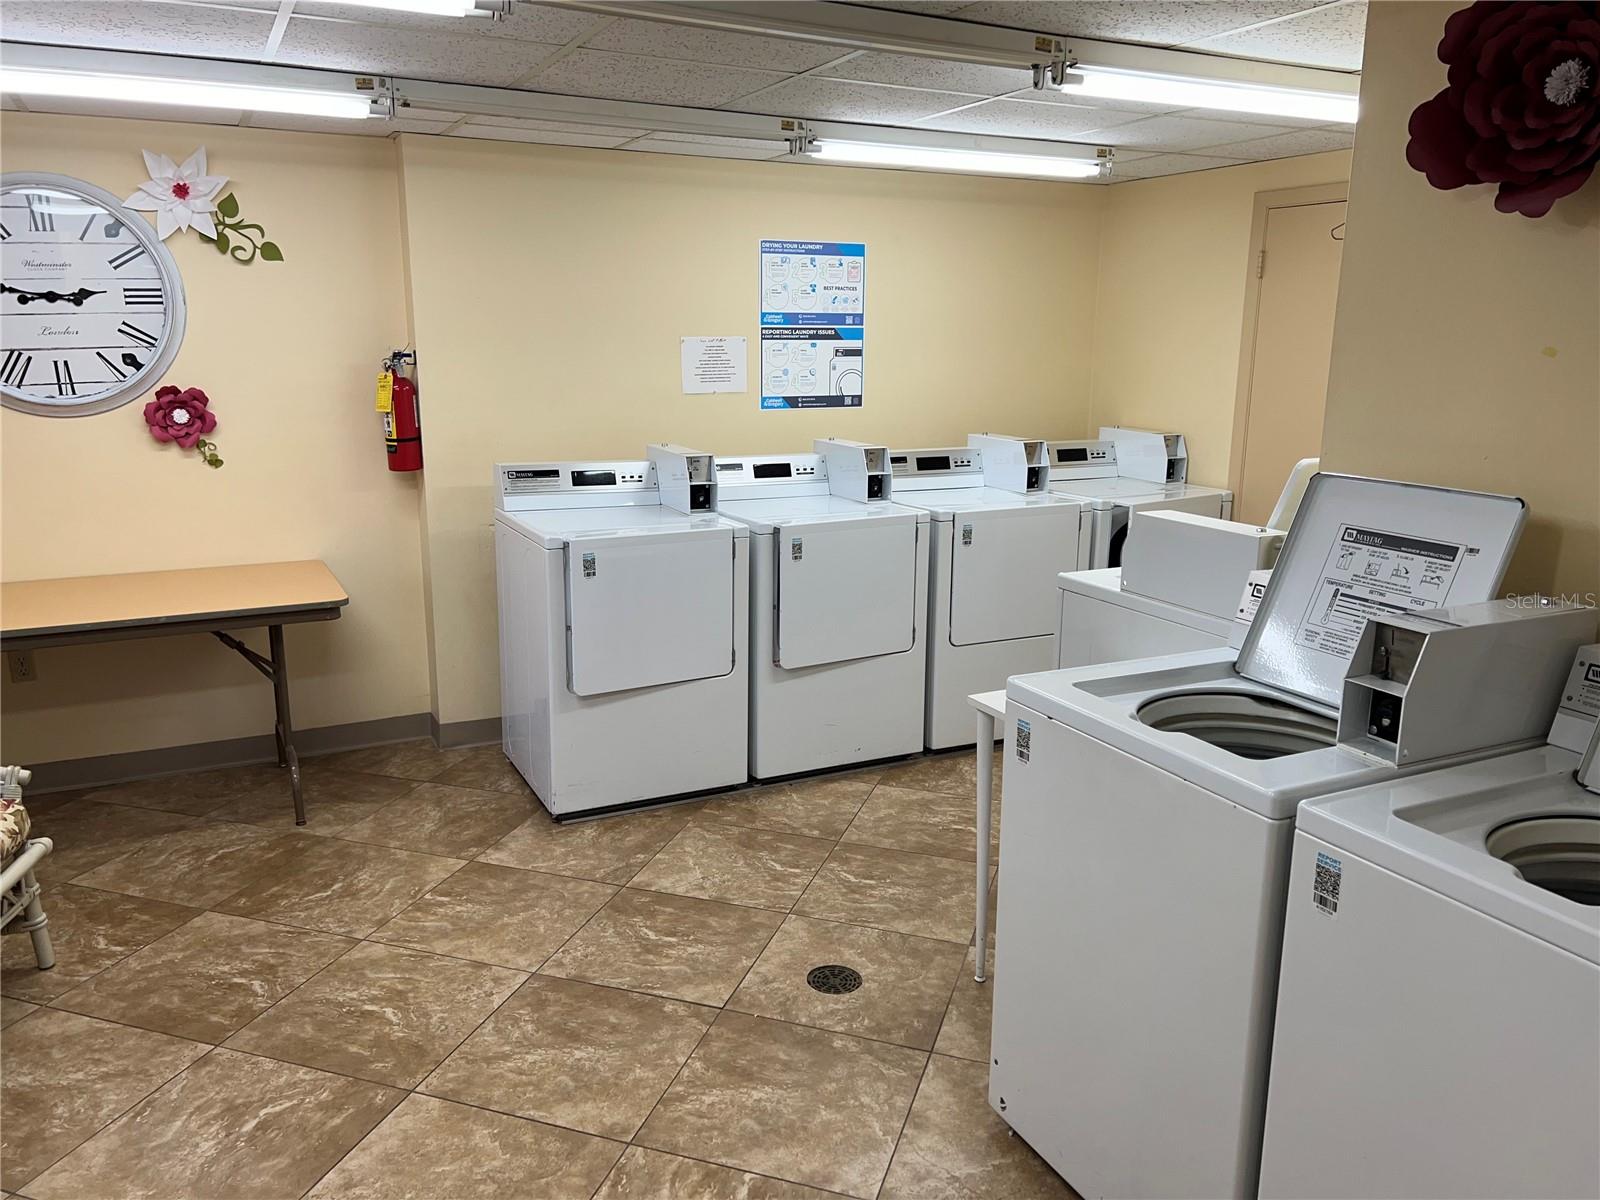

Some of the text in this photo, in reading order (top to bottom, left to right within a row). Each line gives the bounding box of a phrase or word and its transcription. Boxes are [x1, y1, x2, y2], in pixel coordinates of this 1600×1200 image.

[21, 259, 72, 268] Westminster
[37, 325, 79, 337] London
[1355, 533, 1383, 546] MAYTAG
[1420, 550, 1453, 560] INSTRUCTIONS
[1326, 579, 1354, 590] TEMPERATURE
[1410, 599, 1426, 607] CYCLE
[1318, 852, 1341, 866] REPORT
